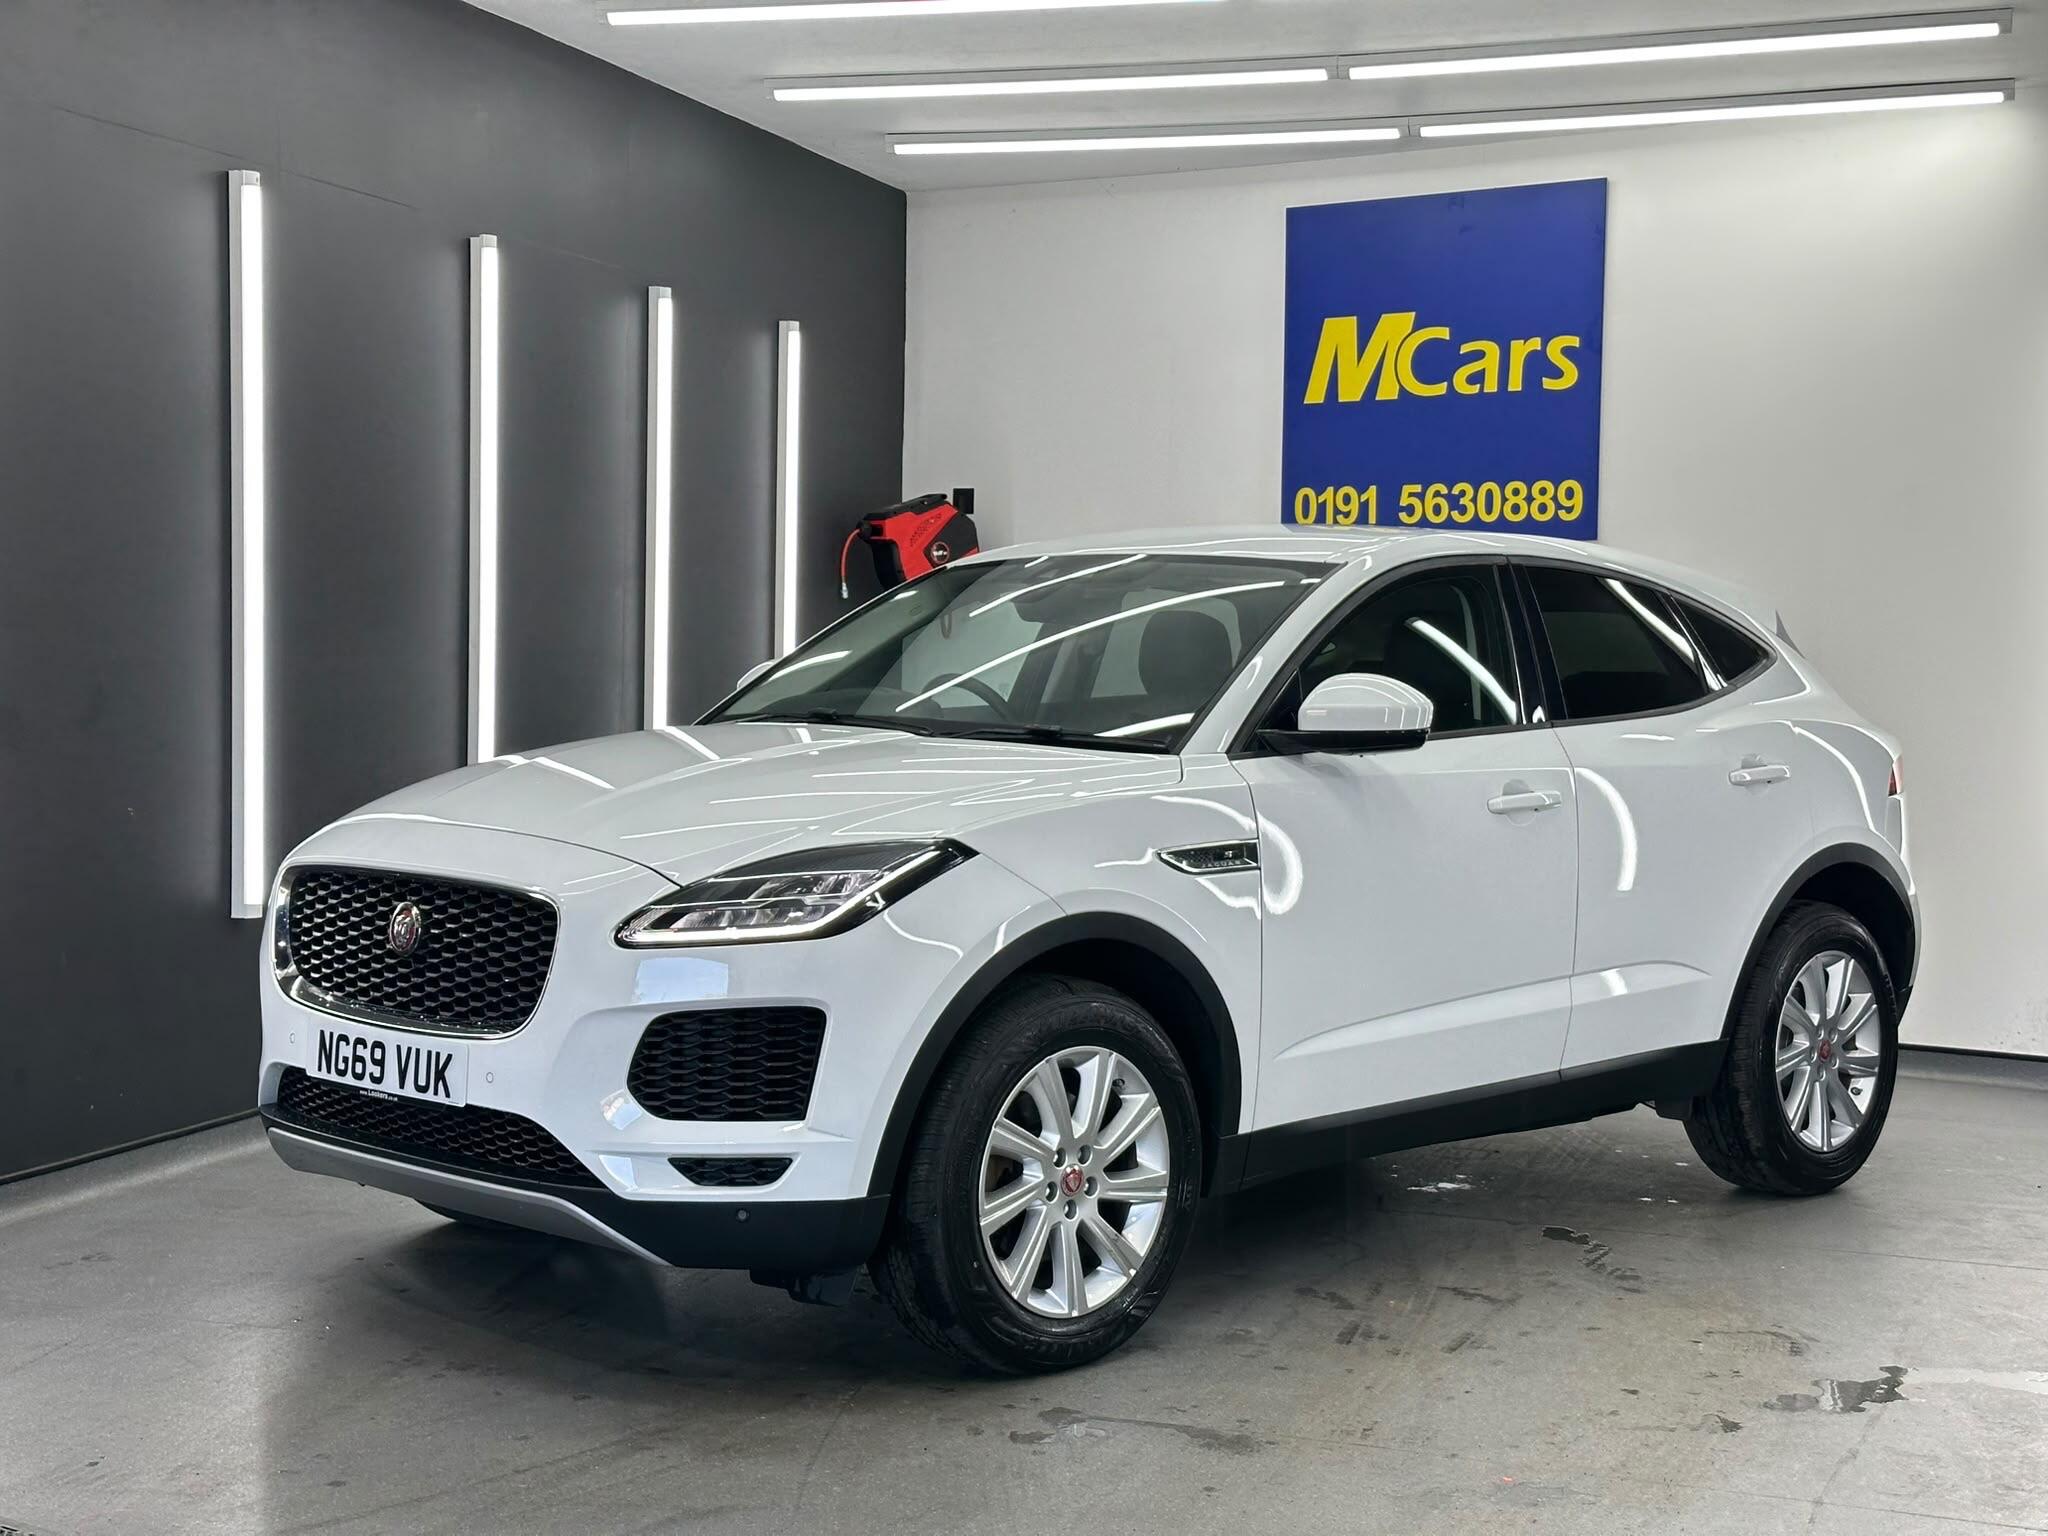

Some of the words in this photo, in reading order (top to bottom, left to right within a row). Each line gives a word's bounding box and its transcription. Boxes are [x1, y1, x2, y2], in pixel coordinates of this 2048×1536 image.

[1303, 311, 1580, 404] MCars
[1294, 485, 1377, 525] 0191
[1398, 479, 1583, 524] 5630889
[317, 1029, 386, 1085] NG69
[396, 1044, 453, 1098] VUK
